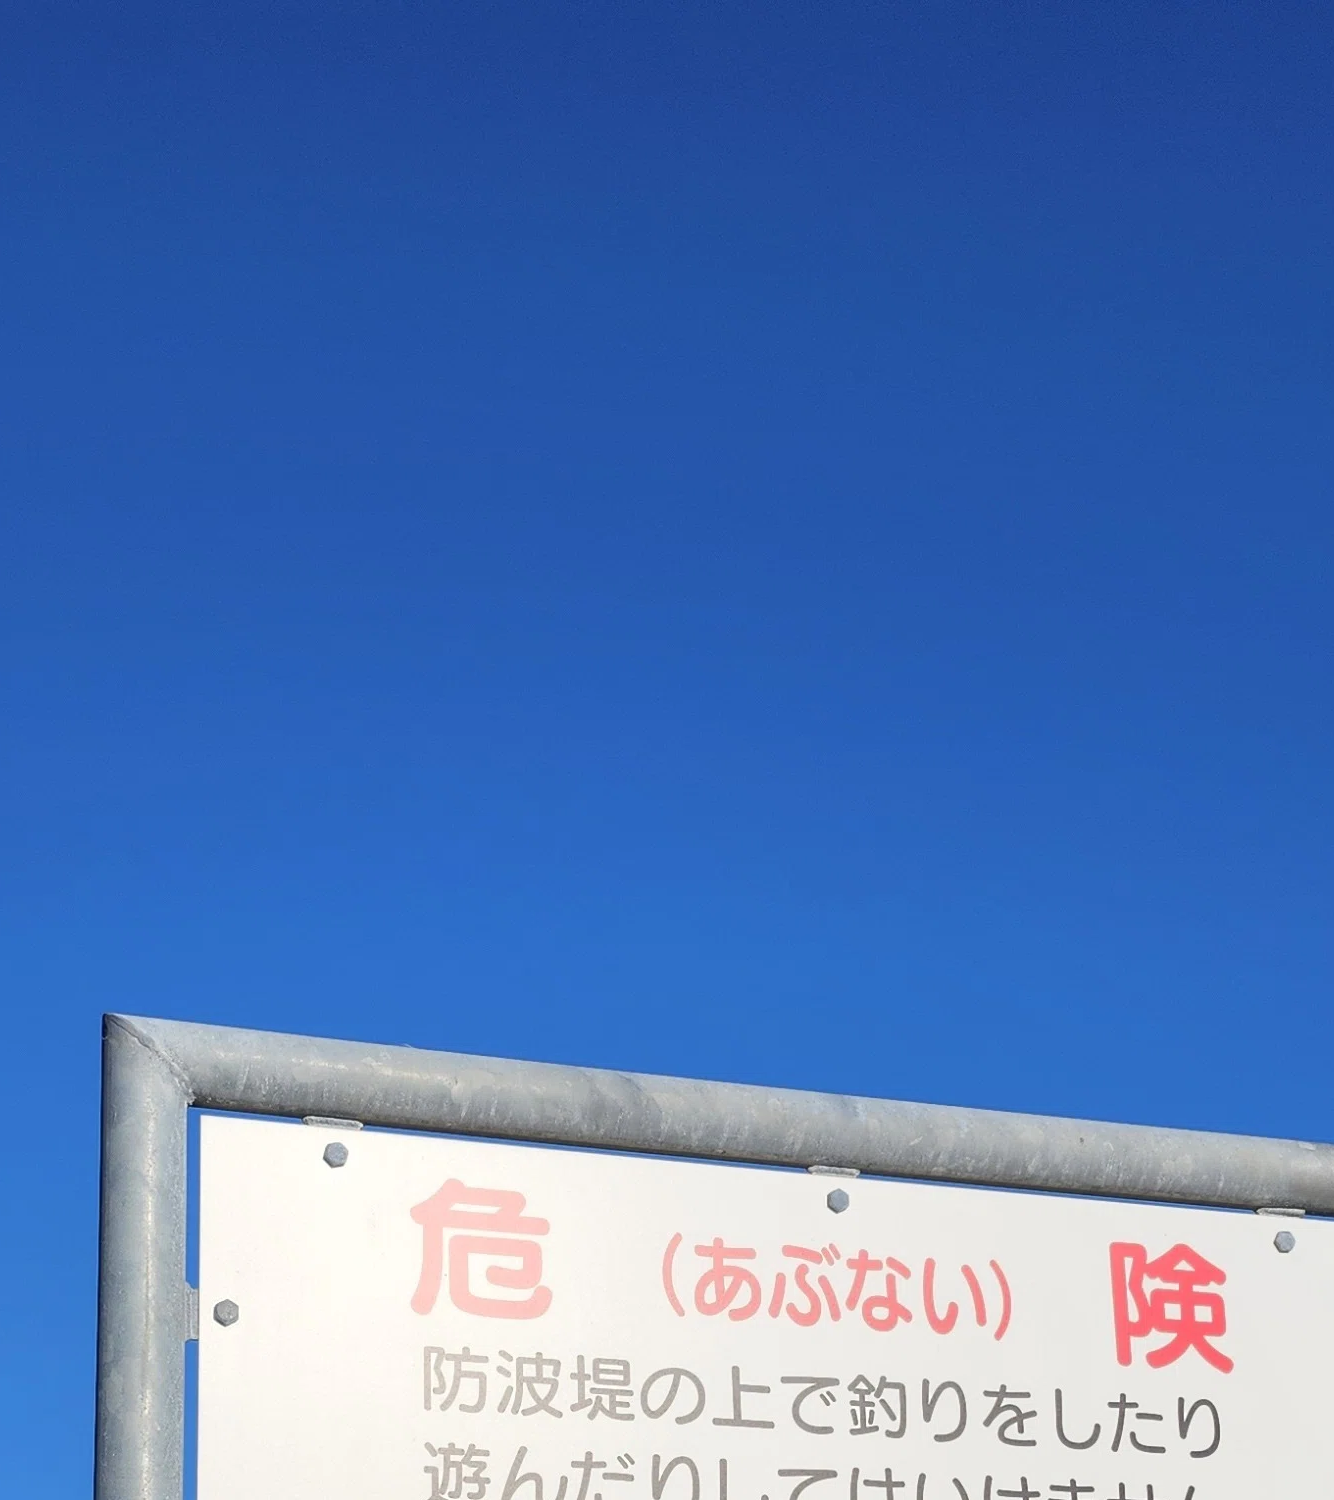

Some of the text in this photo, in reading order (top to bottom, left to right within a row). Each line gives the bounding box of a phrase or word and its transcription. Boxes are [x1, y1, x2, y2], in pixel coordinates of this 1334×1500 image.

[410, 1178, 553, 1320] 危
[1107, 1240, 1236, 1376] 険
[422, 1345, 1223, 1460] 防波堤の上で釣りをしたり
